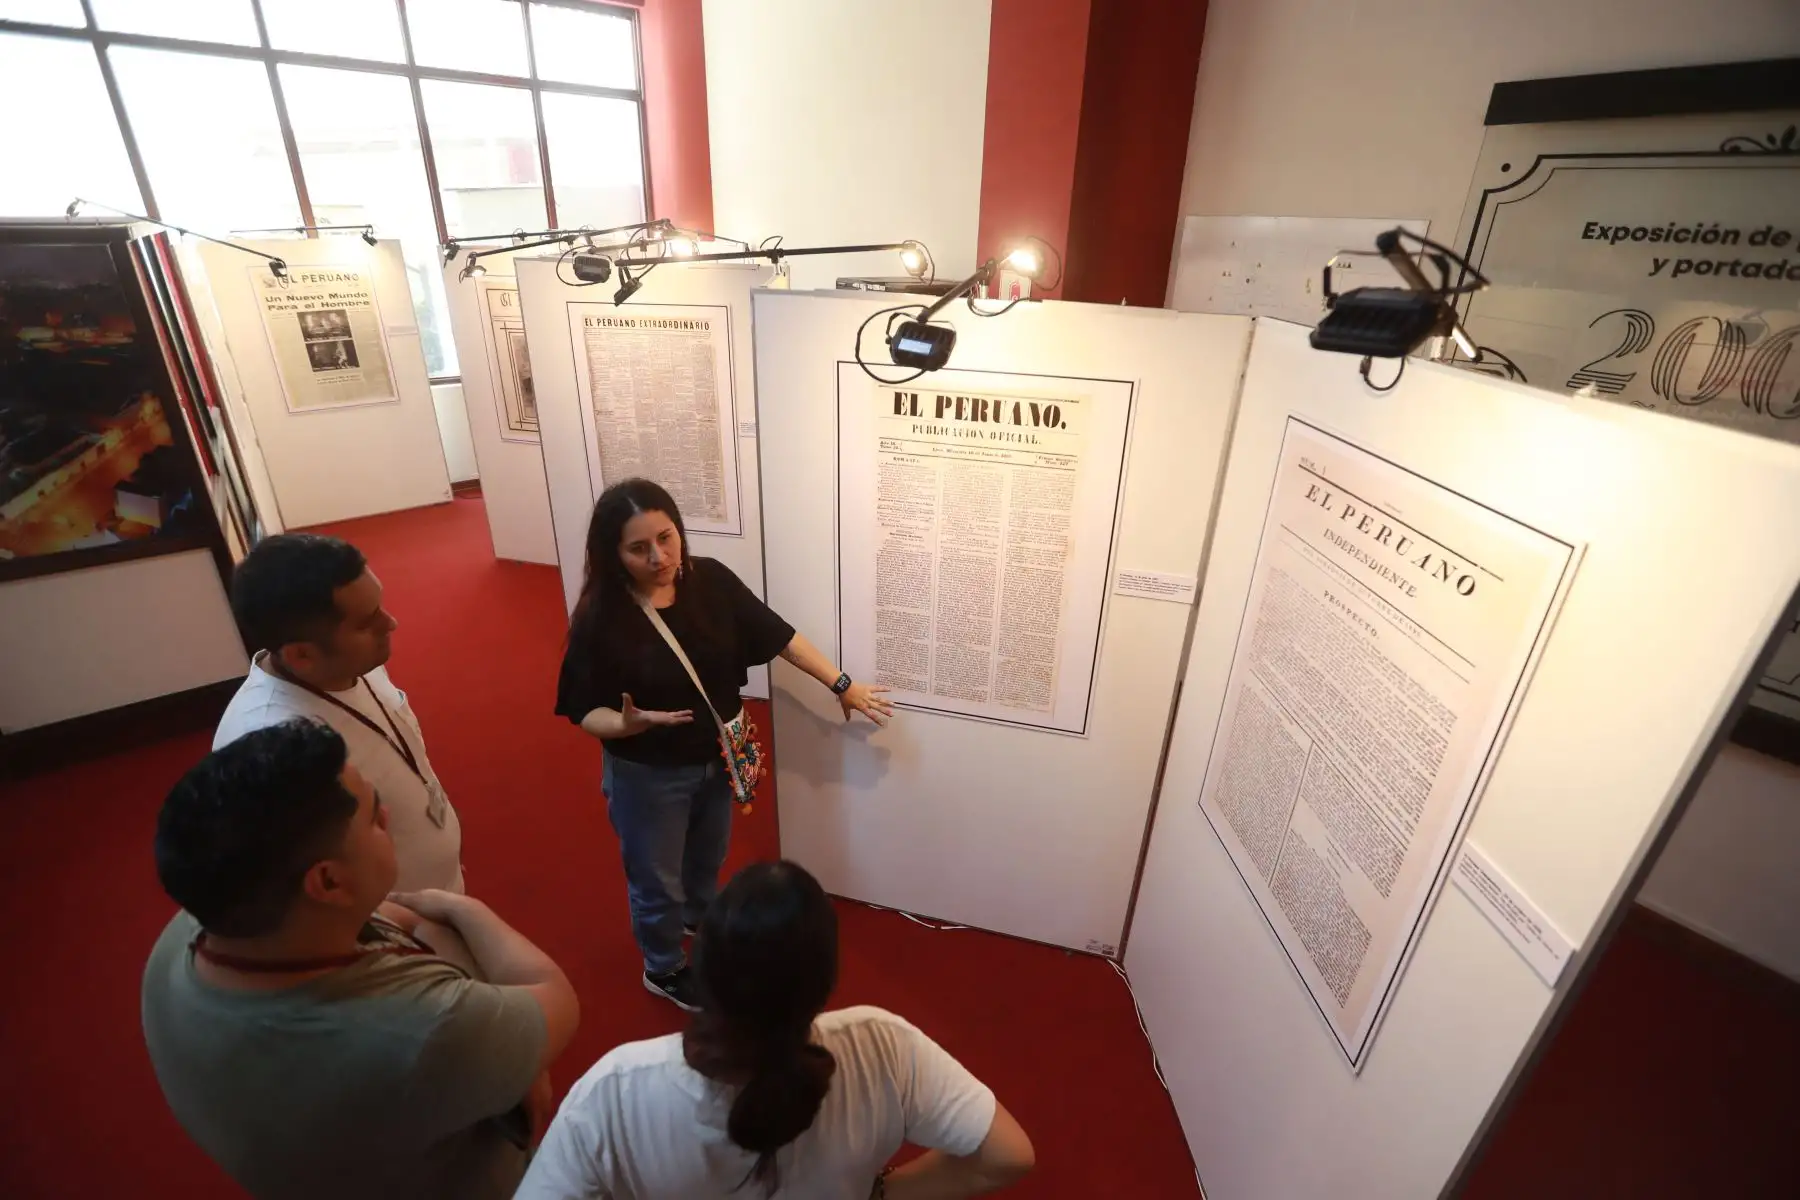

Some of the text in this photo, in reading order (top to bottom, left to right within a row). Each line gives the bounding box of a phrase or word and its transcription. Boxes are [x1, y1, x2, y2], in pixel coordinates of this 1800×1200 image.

[1581, 221, 1741, 246] Exposición
[1747, 224, 1793, 248] de
[1647, 257, 1671, 277] y
[301, 273, 360, 284] PERUANO
[265, 295, 282, 303] Un
[328, 291, 369, 300] Mundo
[267, 303, 299, 311] Para
[320, 300, 371, 308] Hombre
[584, 318, 710, 331] EL PERUANO EXTRAORDINARIO
[893, 391, 1067, 430] EL PERUANO.
[1305, 483, 1476, 597] EL PERUANO
